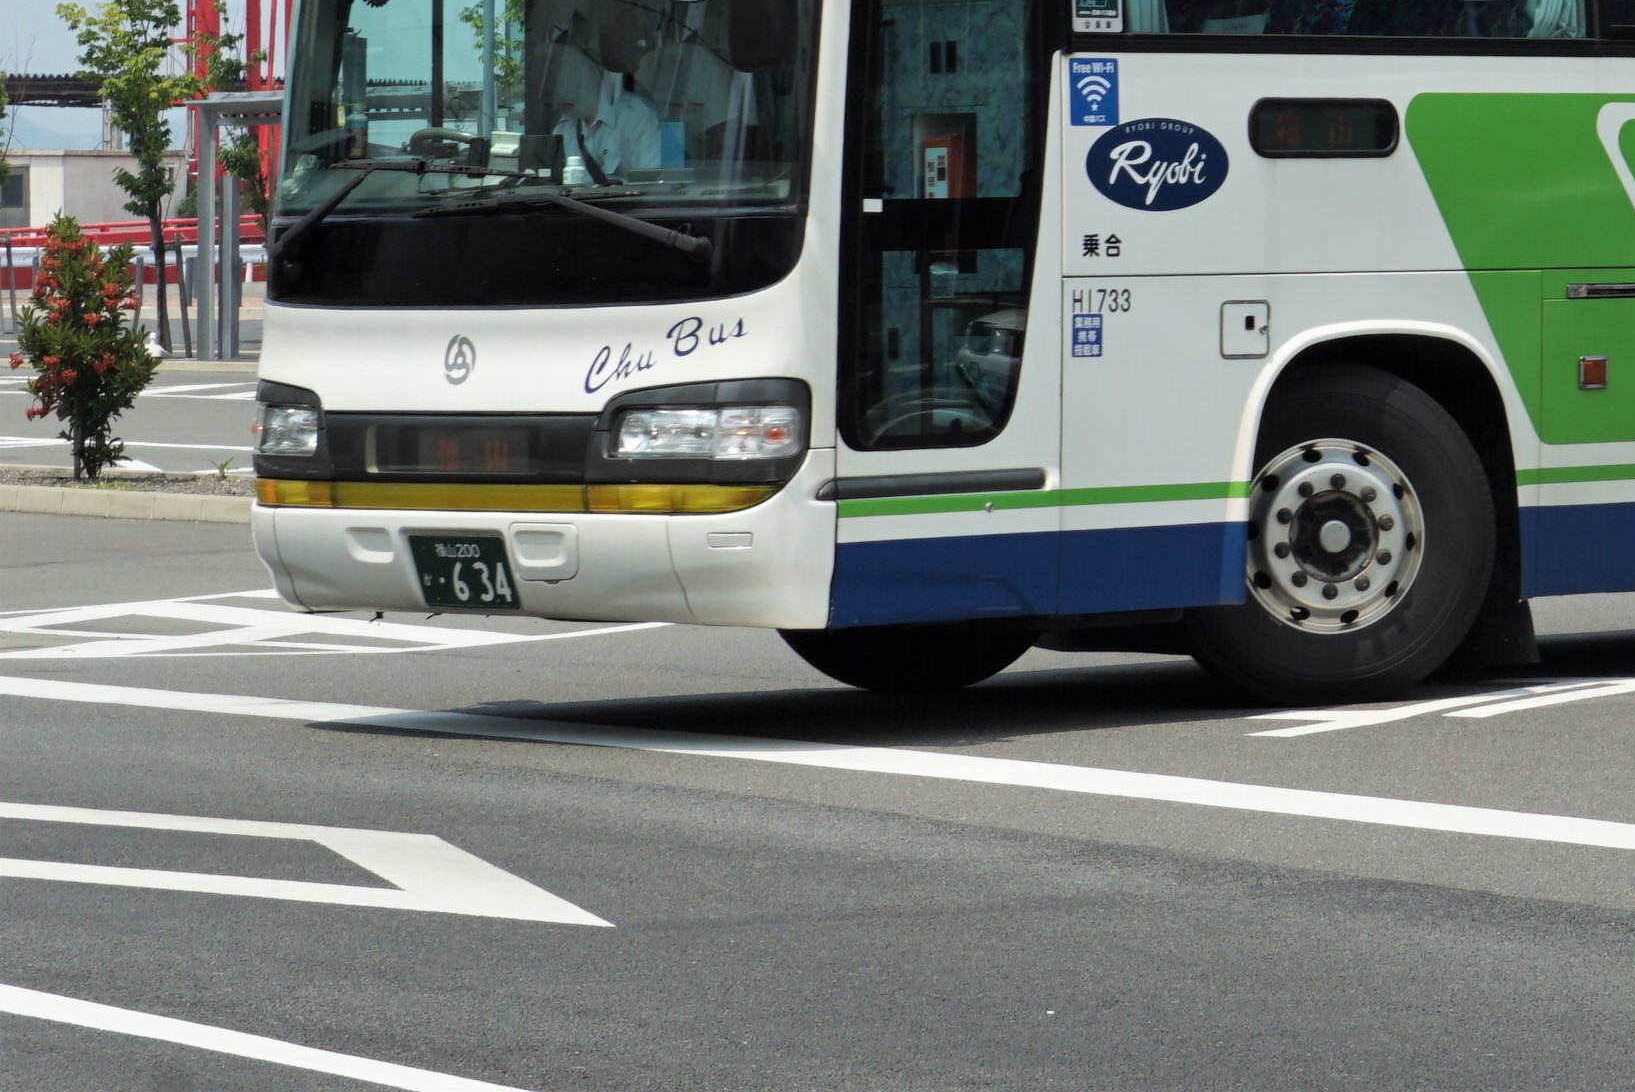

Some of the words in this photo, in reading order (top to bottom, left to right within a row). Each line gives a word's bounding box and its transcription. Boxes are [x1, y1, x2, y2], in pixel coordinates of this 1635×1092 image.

[1072, 62, 1091, 73] Free
[1091, 62, 1114, 73] Wi-Fi
[1125, 121, 1156, 134] RYOBI
[1160, 121, 1195, 135] GROUP
[1109, 140, 1207, 206] Ryobi
[1082, 233, 1122, 258] 乗合
[584, 342, 658, 394] Chu
[666, 316, 749, 357] Bus
